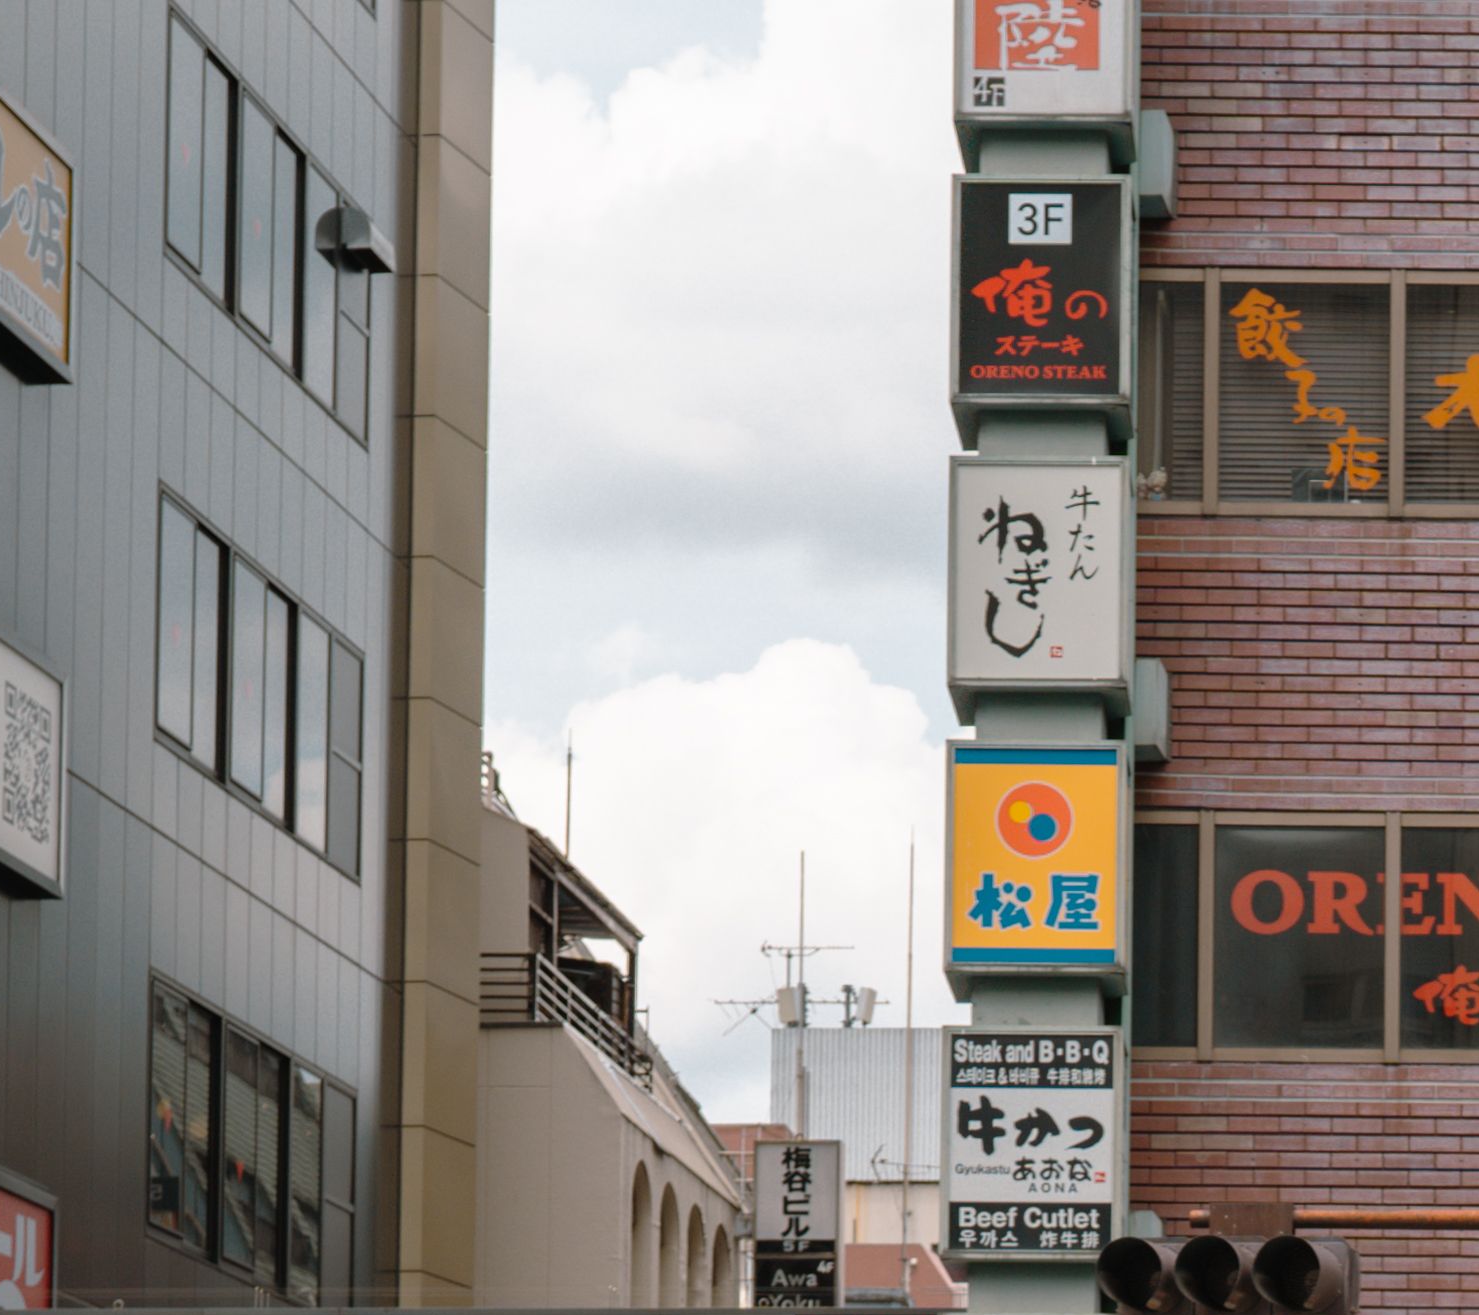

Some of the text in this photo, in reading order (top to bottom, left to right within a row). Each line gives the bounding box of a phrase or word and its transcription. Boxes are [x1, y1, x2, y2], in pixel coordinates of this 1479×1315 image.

[1016, 202, 1065, 237] 3F
[970, 258, 1109, 328] 俺の
[995, 335, 1085, 357] ステーキ
[970, 365, 1108, 380] ORENO STEAK
[1065, 485, 1102, 582] 牛たん
[977, 494, 1054, 659] ねぎし
[968, 872, 1102, 931] 松屋
[954, 1038, 1002, 1064] Steak
[1005, 1040, 1035, 1063] and
[957, 1094, 1105, 1156] 牛かつ
[1012, 1156, 1093, 1182] あおな
[1027, 1183, 1078, 1193] AONA
[958, 1206, 1101, 1229] Beef Cutlet
[770, 1268, 819, 1288] Awa
